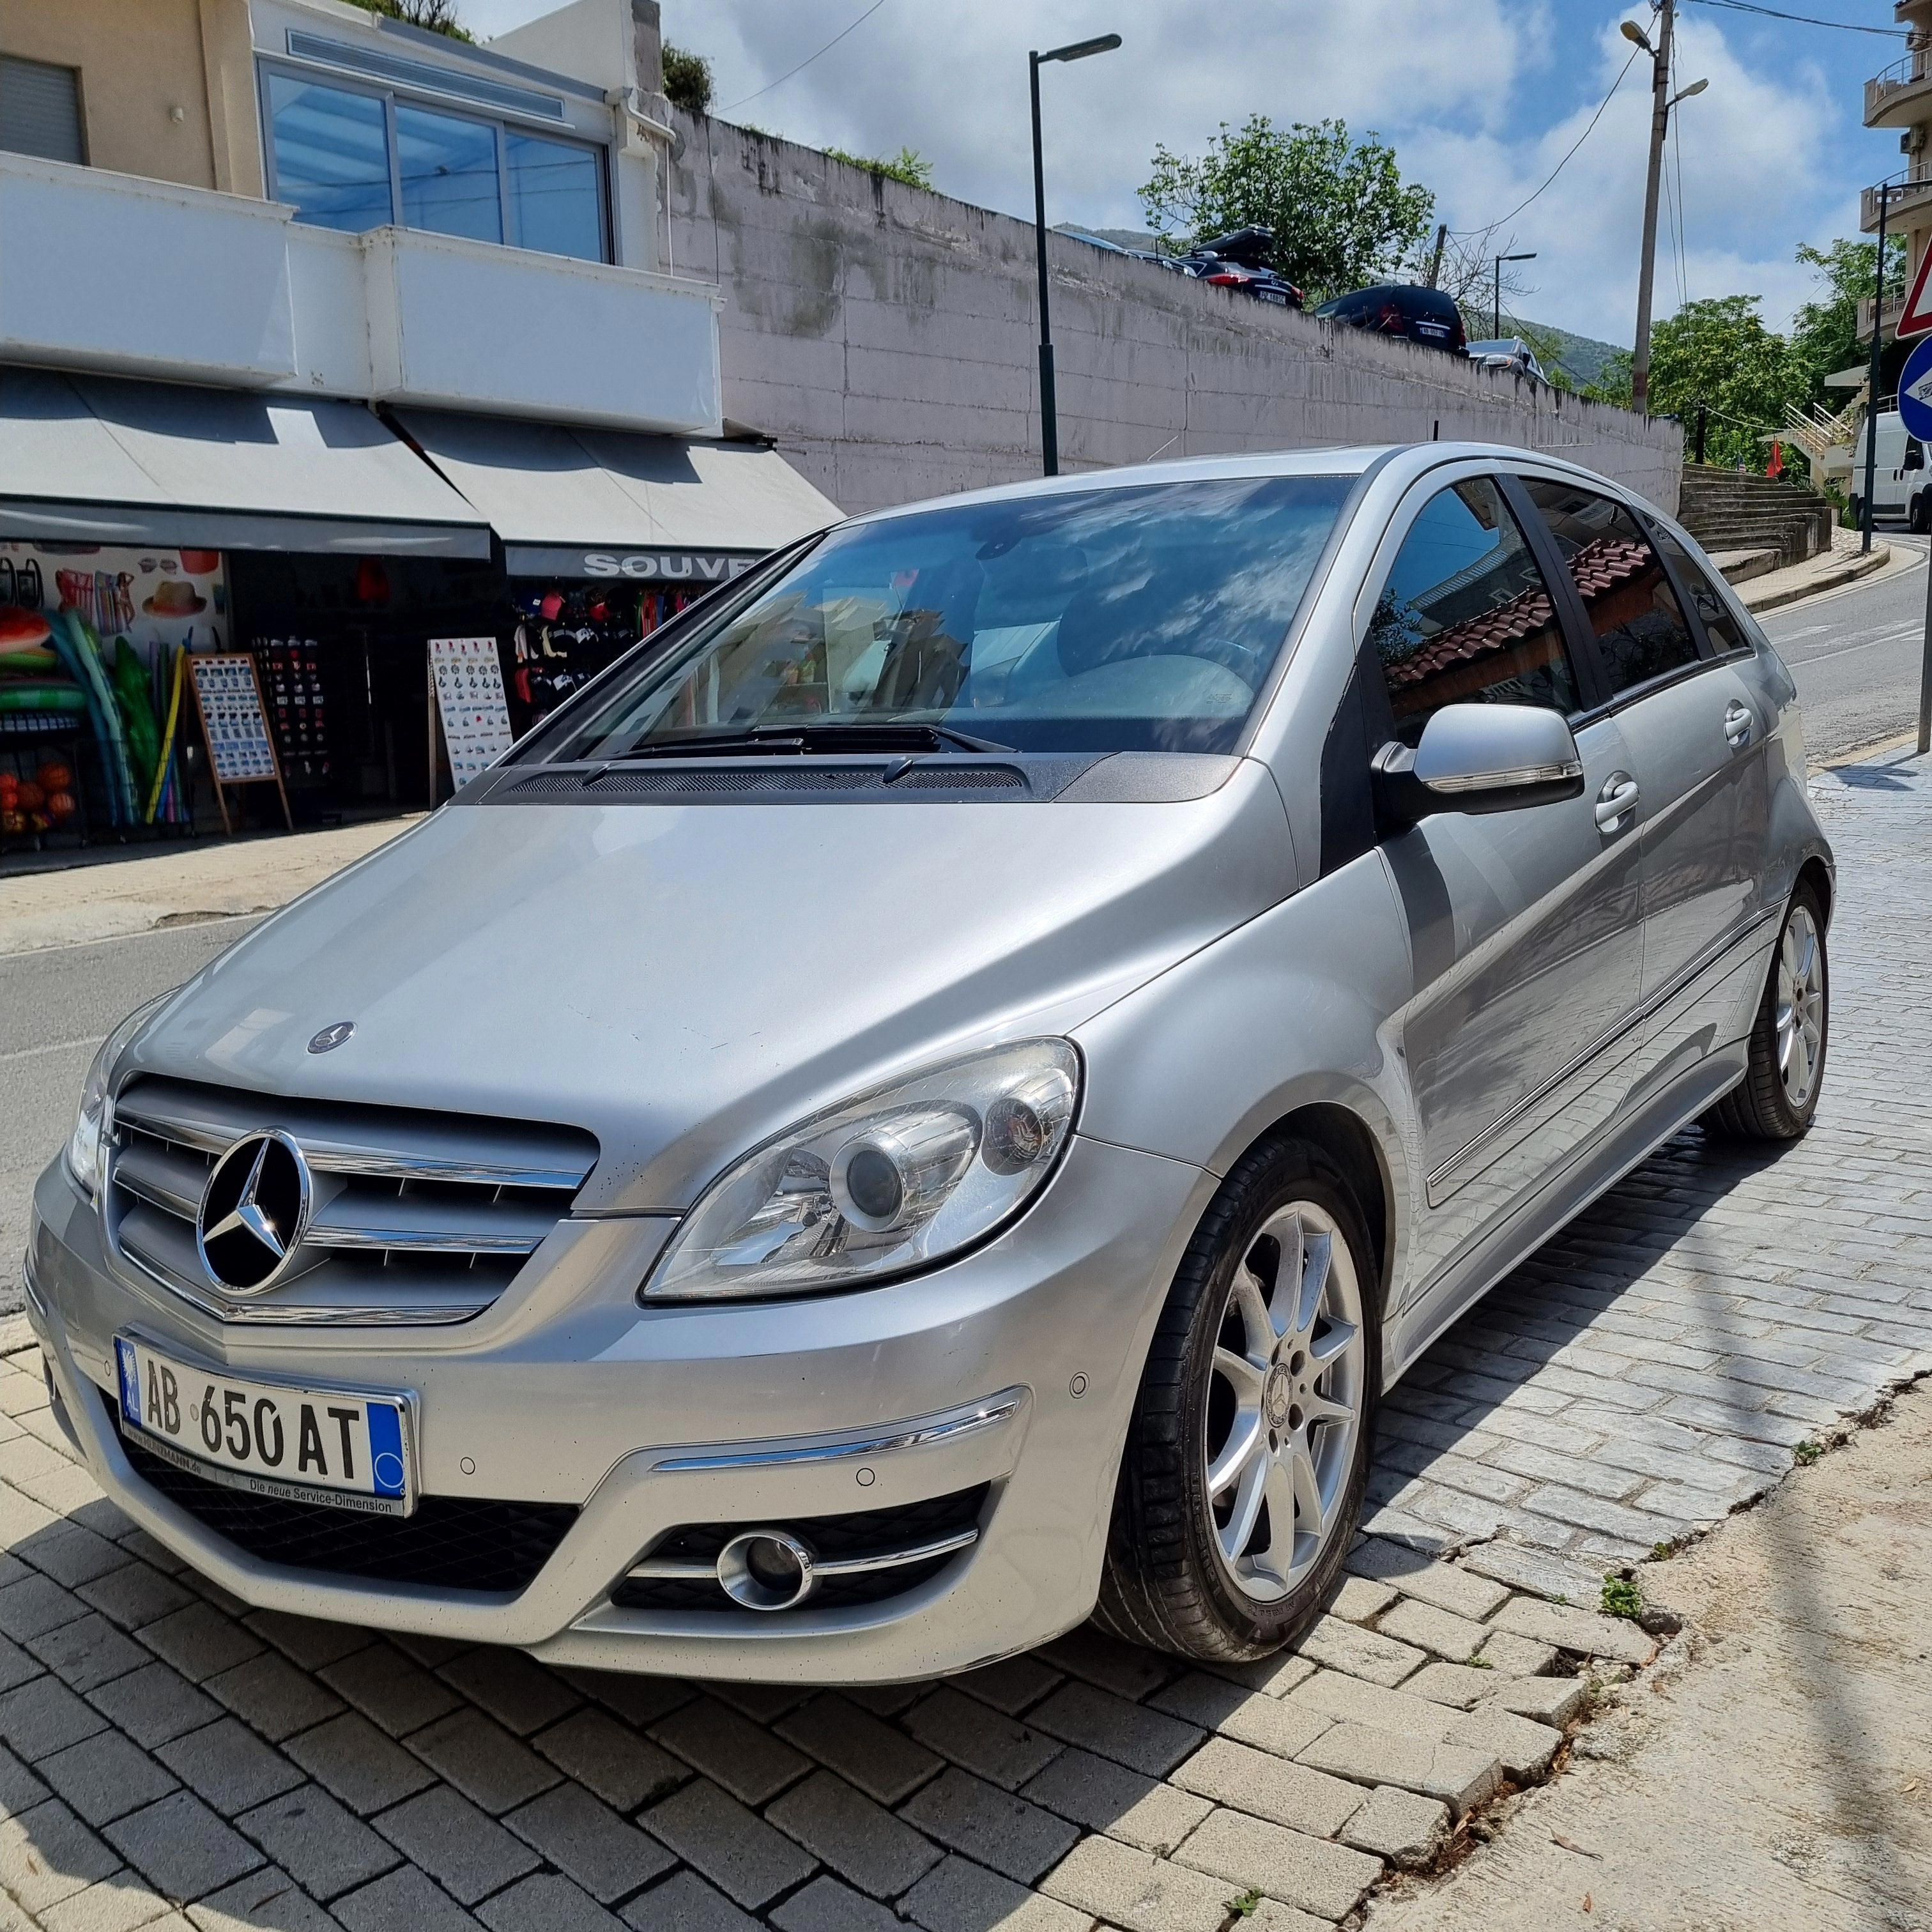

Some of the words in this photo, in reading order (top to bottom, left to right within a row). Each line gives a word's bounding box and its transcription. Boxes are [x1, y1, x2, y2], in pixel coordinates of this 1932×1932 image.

[126, 1391, 139, 1413] AL
[148, 1359, 181, 1435] AB
[201, 1384, 284, 1467] 650
[298, 1404, 360, 1479] AT
[250, 1478, 265, 1492] Die
[267, 1485, 291, 1498] neue
[293, 1488, 392, 1514] Service-Dimension
